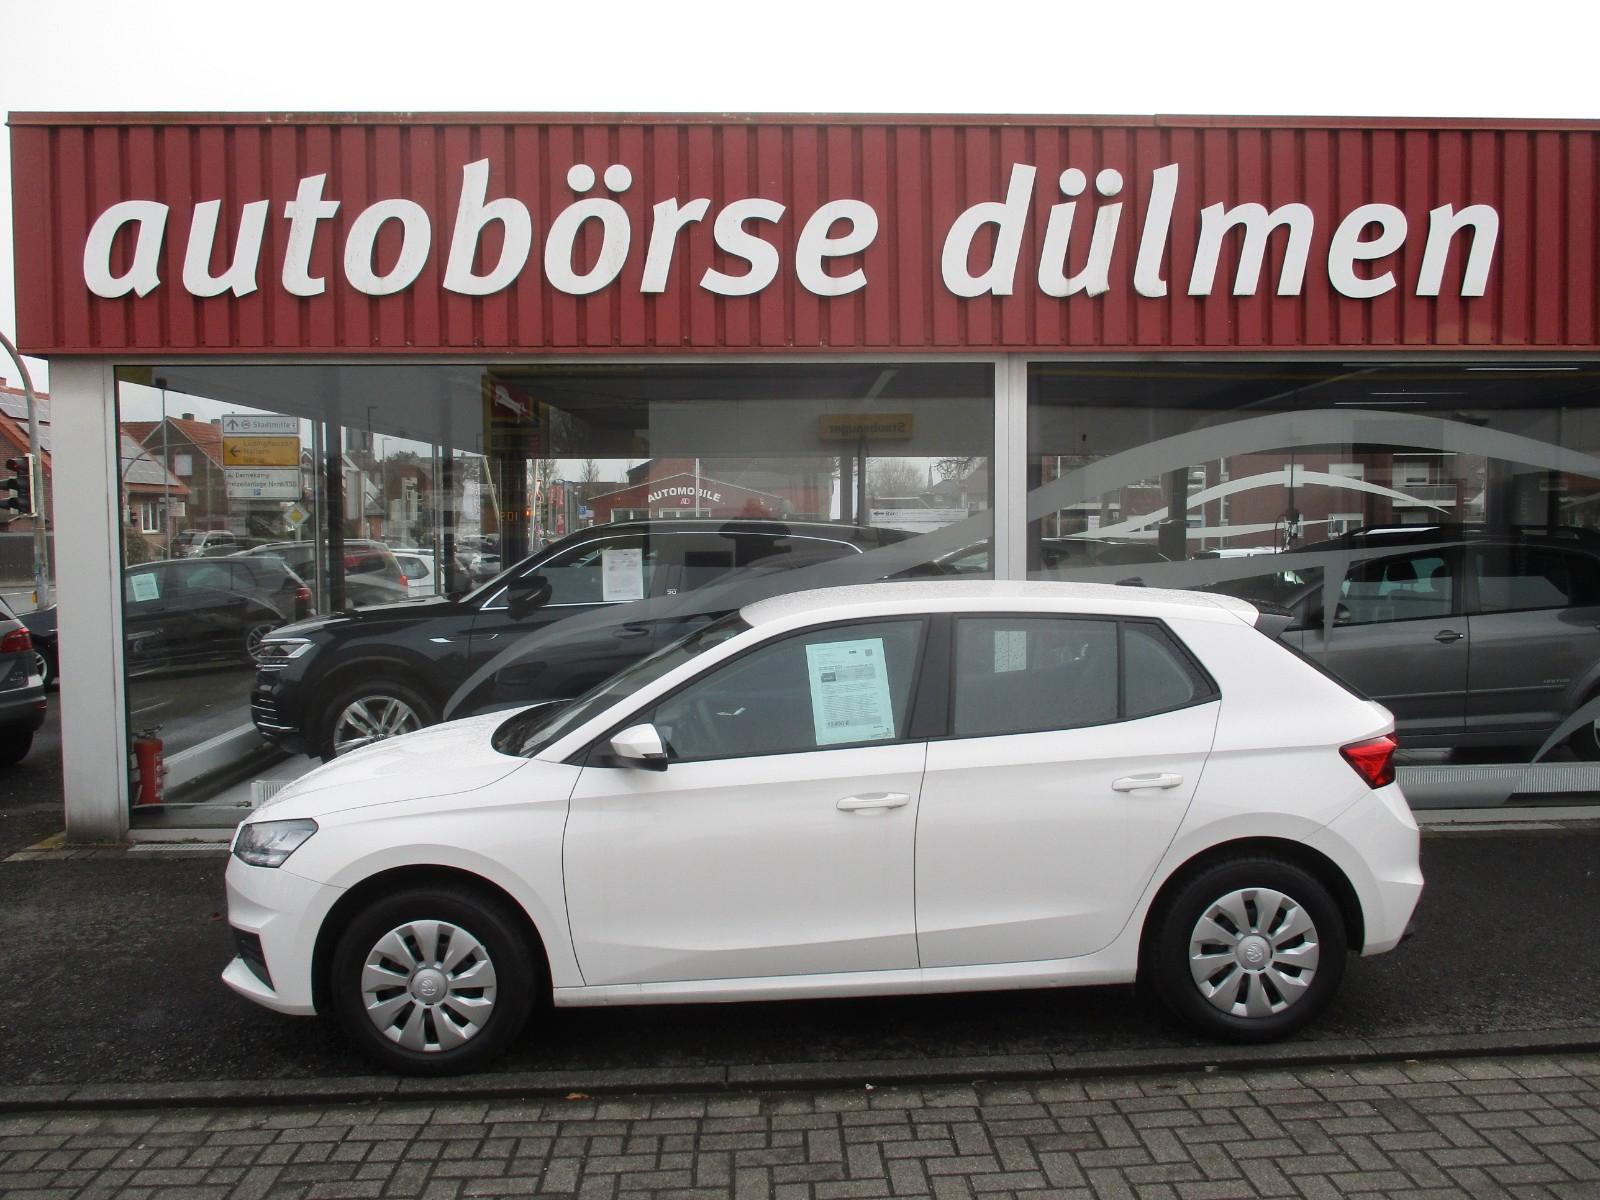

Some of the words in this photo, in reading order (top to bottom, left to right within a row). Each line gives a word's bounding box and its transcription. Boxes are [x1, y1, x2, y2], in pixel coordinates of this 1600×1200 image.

[83, 157, 880, 299] autobörse
[941, 162, 1500, 299] dülmen
[647, 486, 721, 503] AUTOMOBILE
